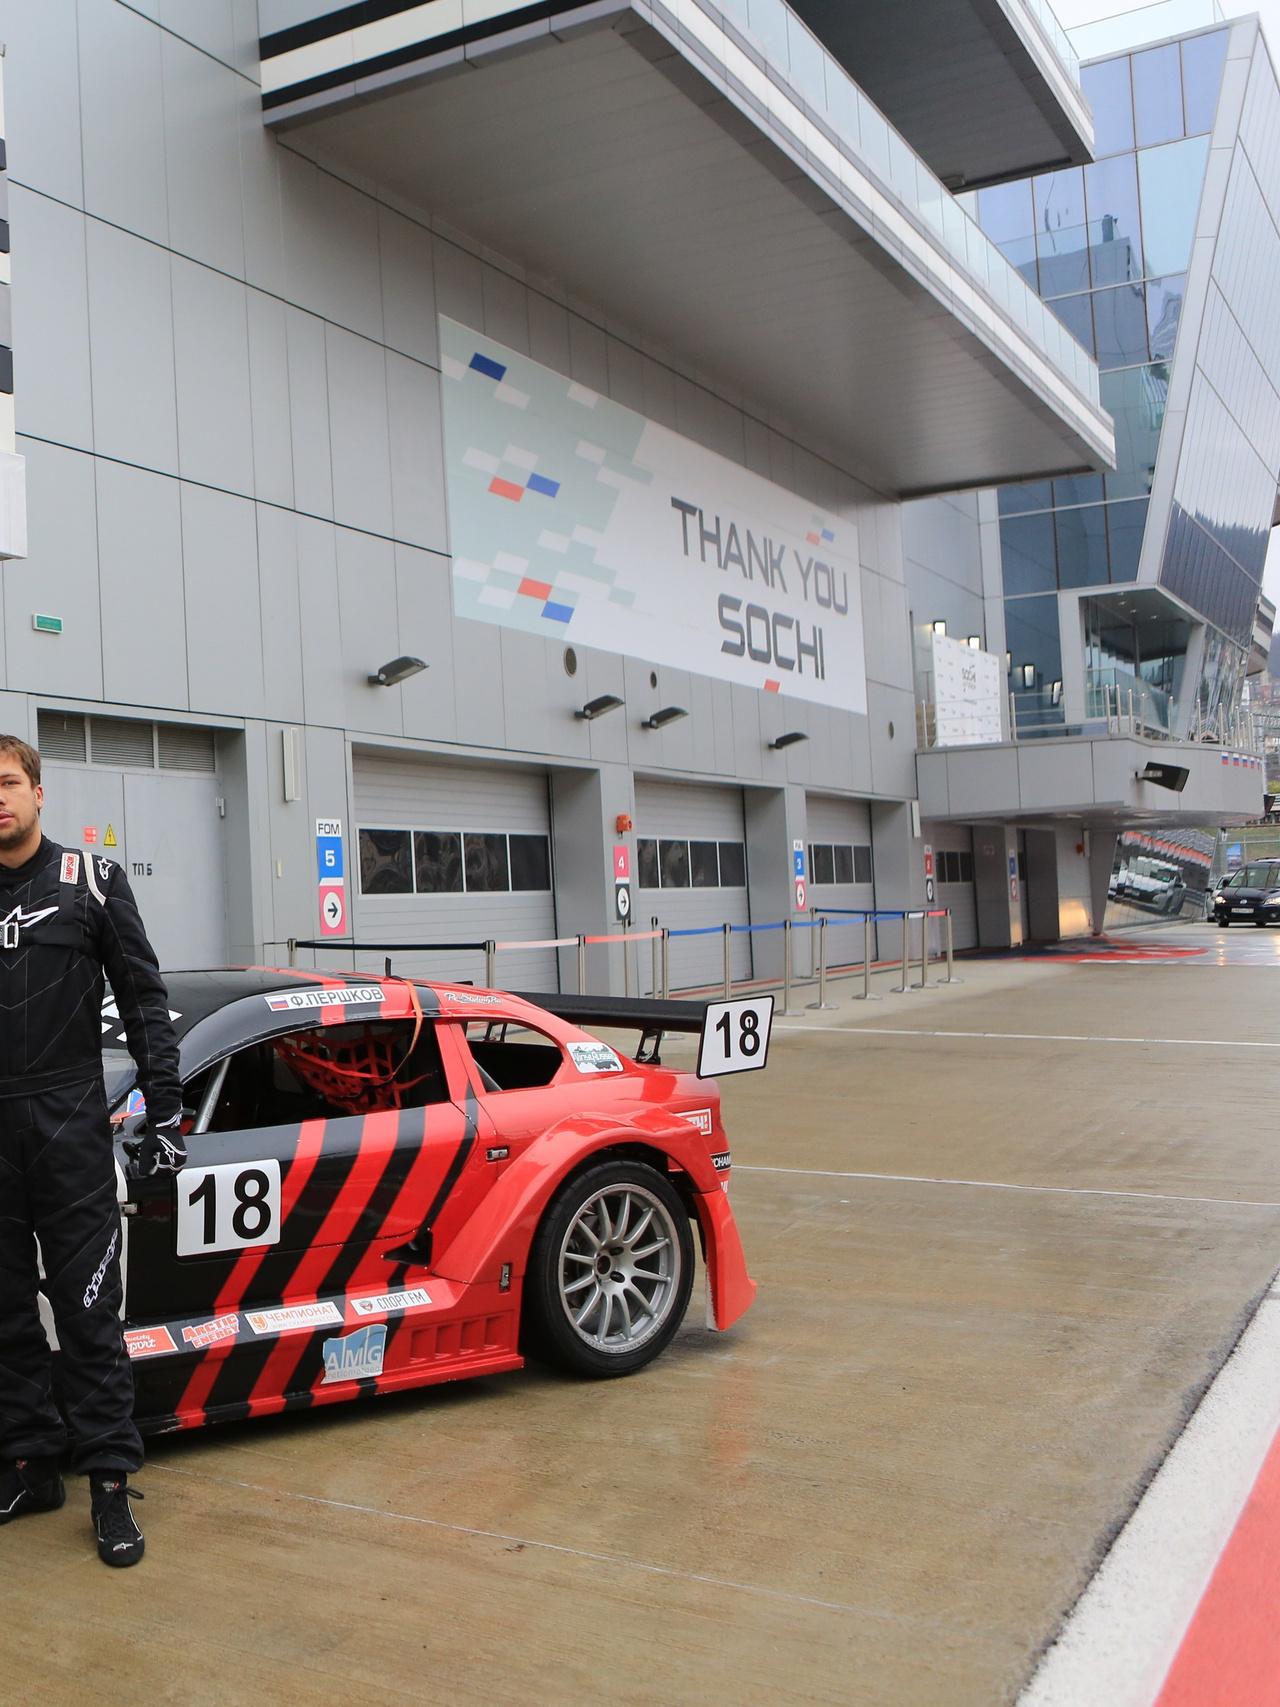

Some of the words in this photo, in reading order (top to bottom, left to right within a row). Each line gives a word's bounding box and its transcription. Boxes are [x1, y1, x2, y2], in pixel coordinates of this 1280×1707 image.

[670, 496, 788, 594] THANK
[793, 549, 849, 616] YOU
[717, 592, 826, 681] SOCHI
[318, 823, 340, 836] FOM
[65, 855, 75, 881] SIMPSON
[132, 863, 145, 876] ТП
[325, 850, 336, 867] 5
[618, 855, 625, 870] 4
[290, 987, 383, 1007] Ф.ПЕРШКОВ
[715, 1009, 761, 1059] 18
[188, 1168, 272, 1245] 18
[376, 1294, 408, 1310] СПОРТ
[408, 1291, 426, 1306] FM
[266, 1304, 334, 1322] ЧЕМПИОНАТ
[183, 1314, 238, 1342] ARCTIC
[193, 1324, 240, 1348] ENERGY
[126, 1339, 157, 1354] port
[326, 1345, 382, 1370] AMG
